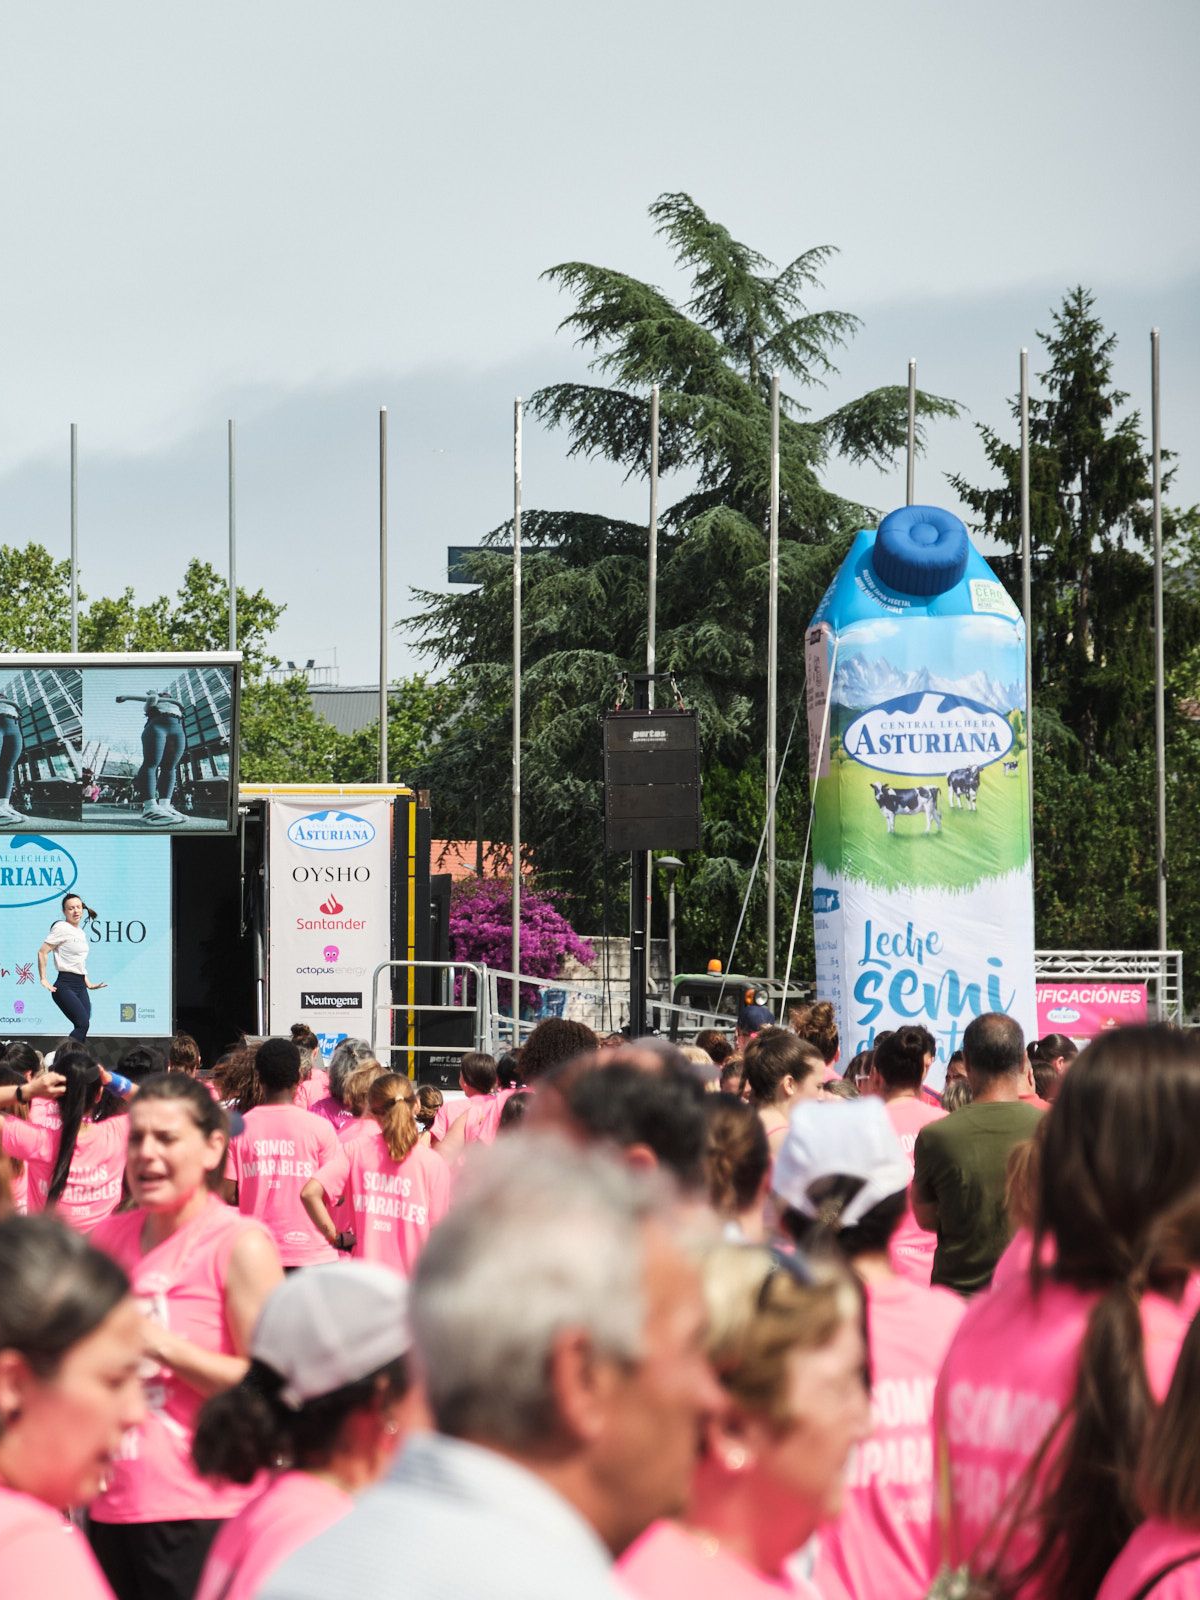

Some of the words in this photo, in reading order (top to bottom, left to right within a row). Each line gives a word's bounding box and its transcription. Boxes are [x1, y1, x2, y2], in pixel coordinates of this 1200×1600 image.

[880, 720, 936, 730] CENTRAL
[940, 719, 996, 729] LECHERA
[853, 723, 1002, 755] ASTURIANA
[295, 825, 368, 840] ASTURIANA
[14, 854, 61, 863] LECHERA
[292, 866, 371, 883] OYSHO
[296, 918, 366, 930] Santander
[858, 919, 942, 967] Leche
[296, 966, 334, 976] octopus
[853, 956, 1016, 1026] semi
[1036, 986, 1142, 1004] IFICACIÓNES
[305, 994, 359, 1008] Neutrogena
[253, 1139, 296, 1156] SOMOS
[242, 1158, 313, 1178] IMPARABLES
[363, 1170, 413, 1198] SOMOS
